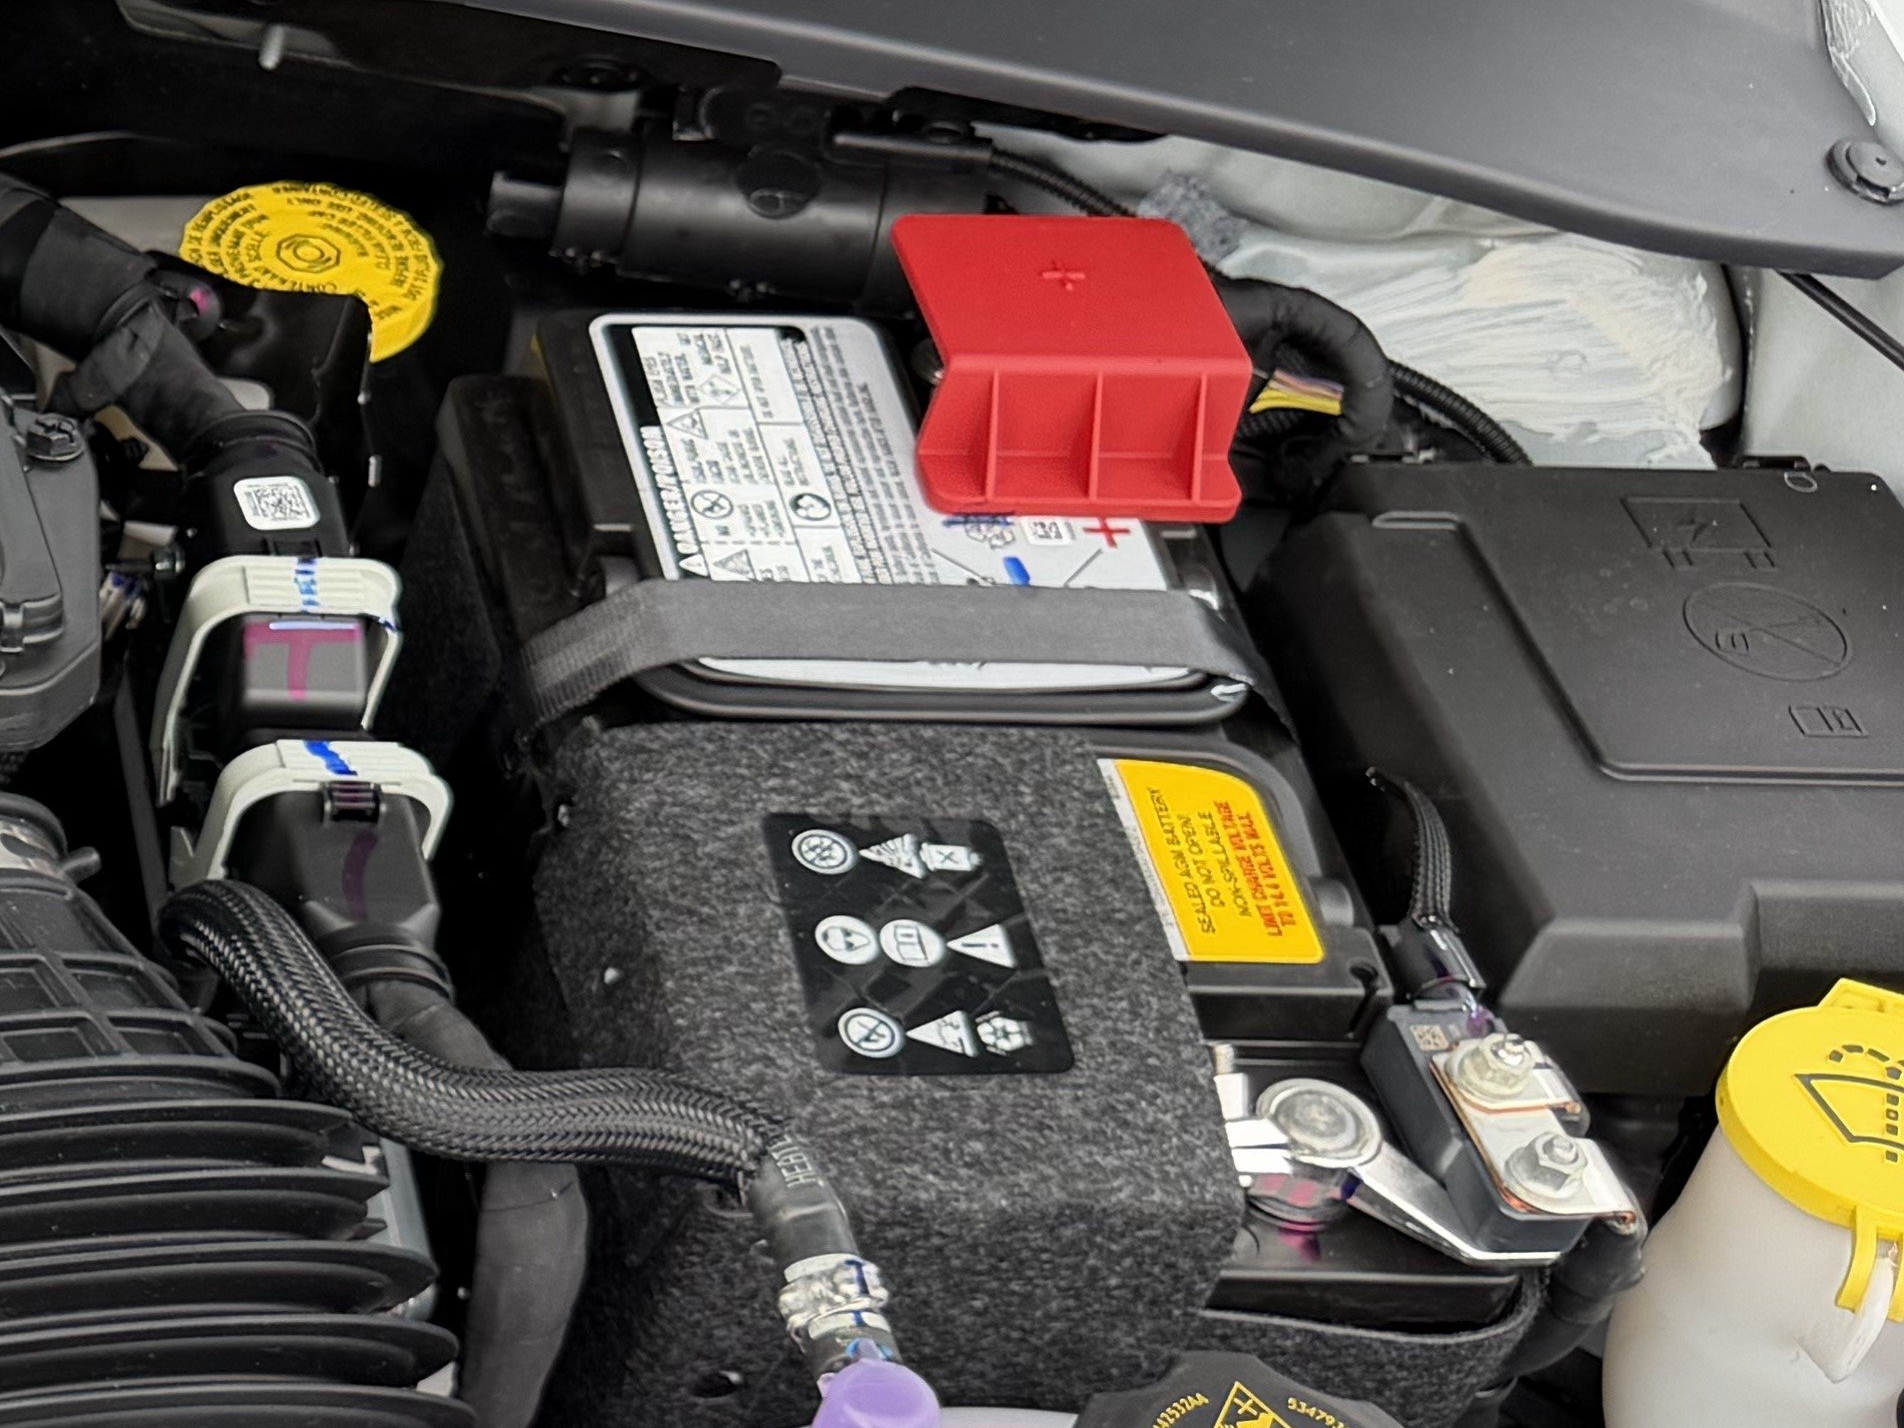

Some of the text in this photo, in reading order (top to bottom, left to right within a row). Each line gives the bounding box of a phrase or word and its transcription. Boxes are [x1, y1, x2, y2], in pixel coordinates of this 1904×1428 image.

[1141, 786, 1185, 845] BATTERY
[1191, 858, 1218, 884] NOT
[1179, 881, 1218, 933] SEALED
